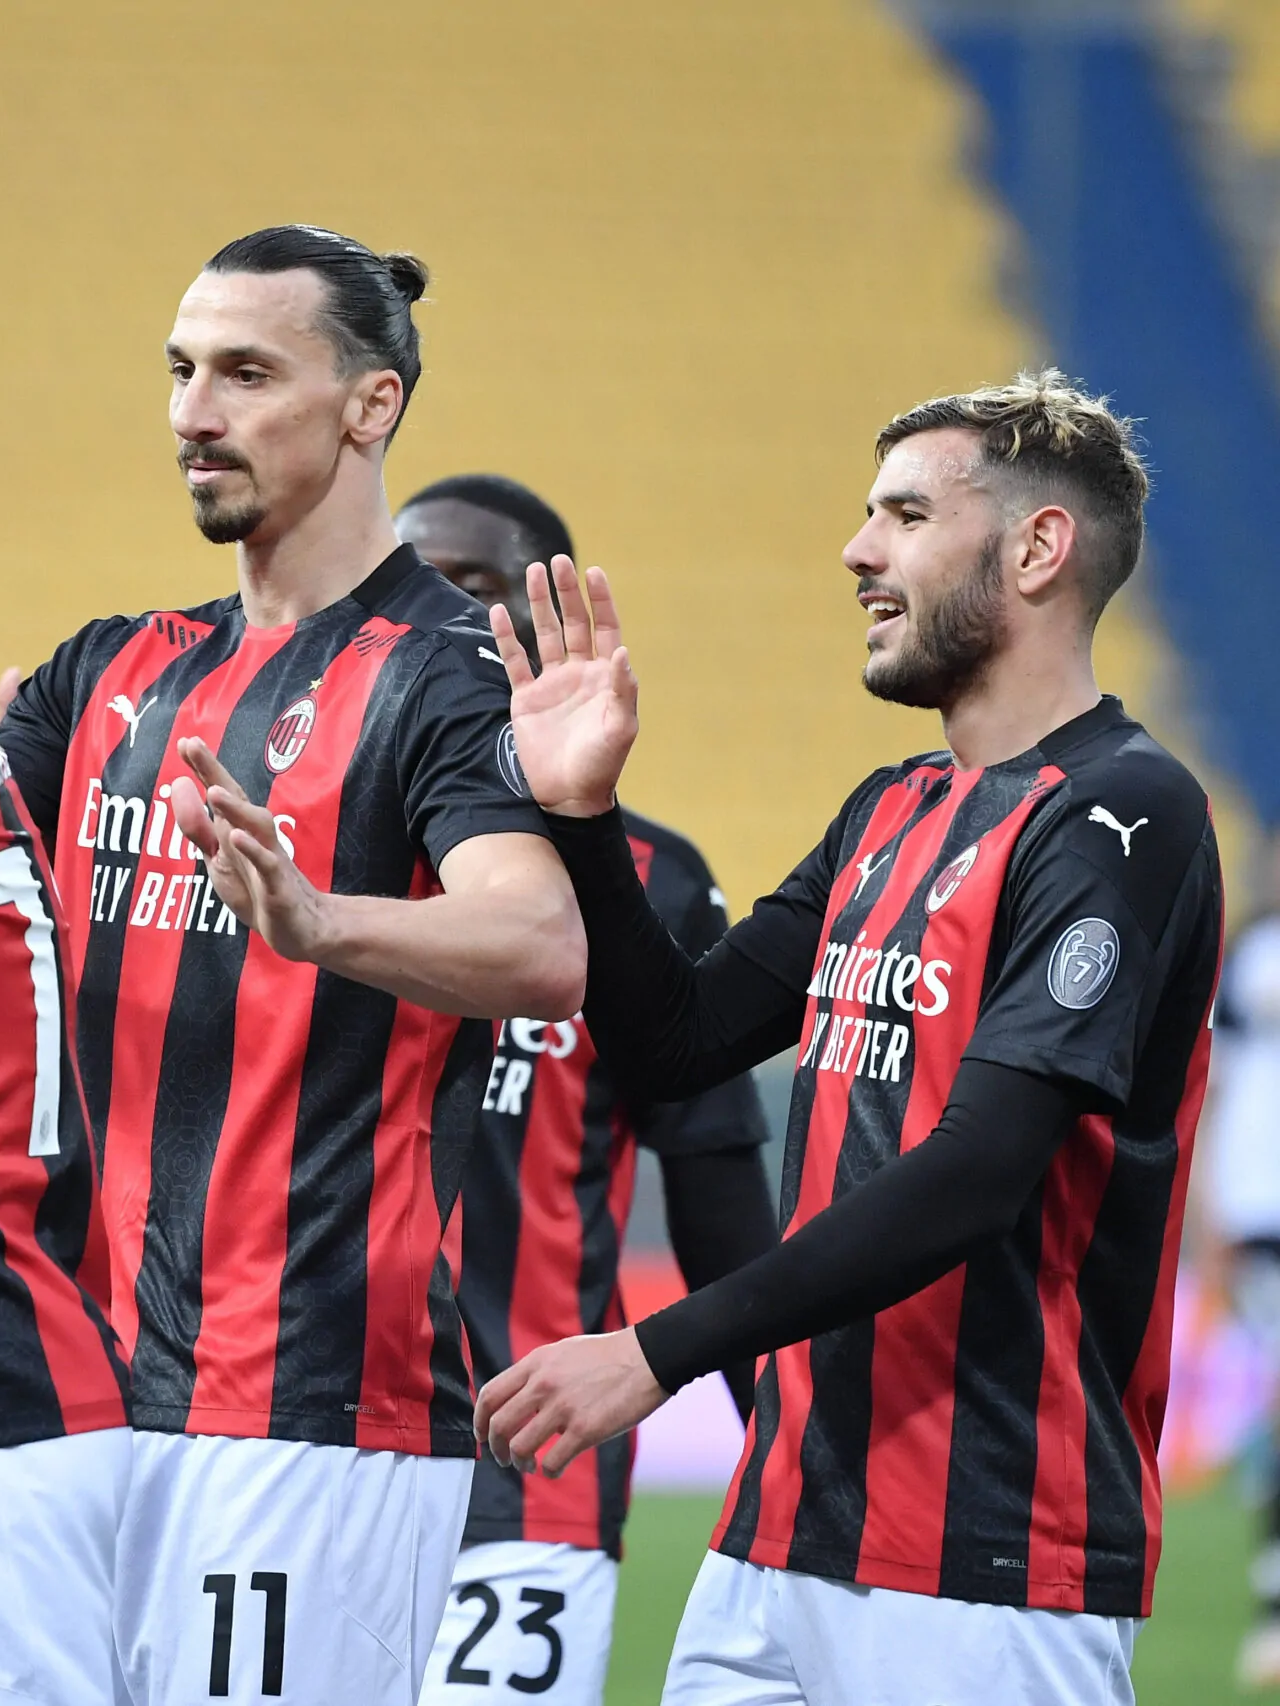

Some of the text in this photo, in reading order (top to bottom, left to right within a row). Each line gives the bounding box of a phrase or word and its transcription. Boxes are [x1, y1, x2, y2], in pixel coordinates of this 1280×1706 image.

[1072, 961, 1092, 983] 7
[818, 1015, 909, 1083] BETTER
[992, 1557, 1027, 1569] DRYCELL
[202, 1572, 287, 1697] 11
[445, 1582, 565, 1694] 23
